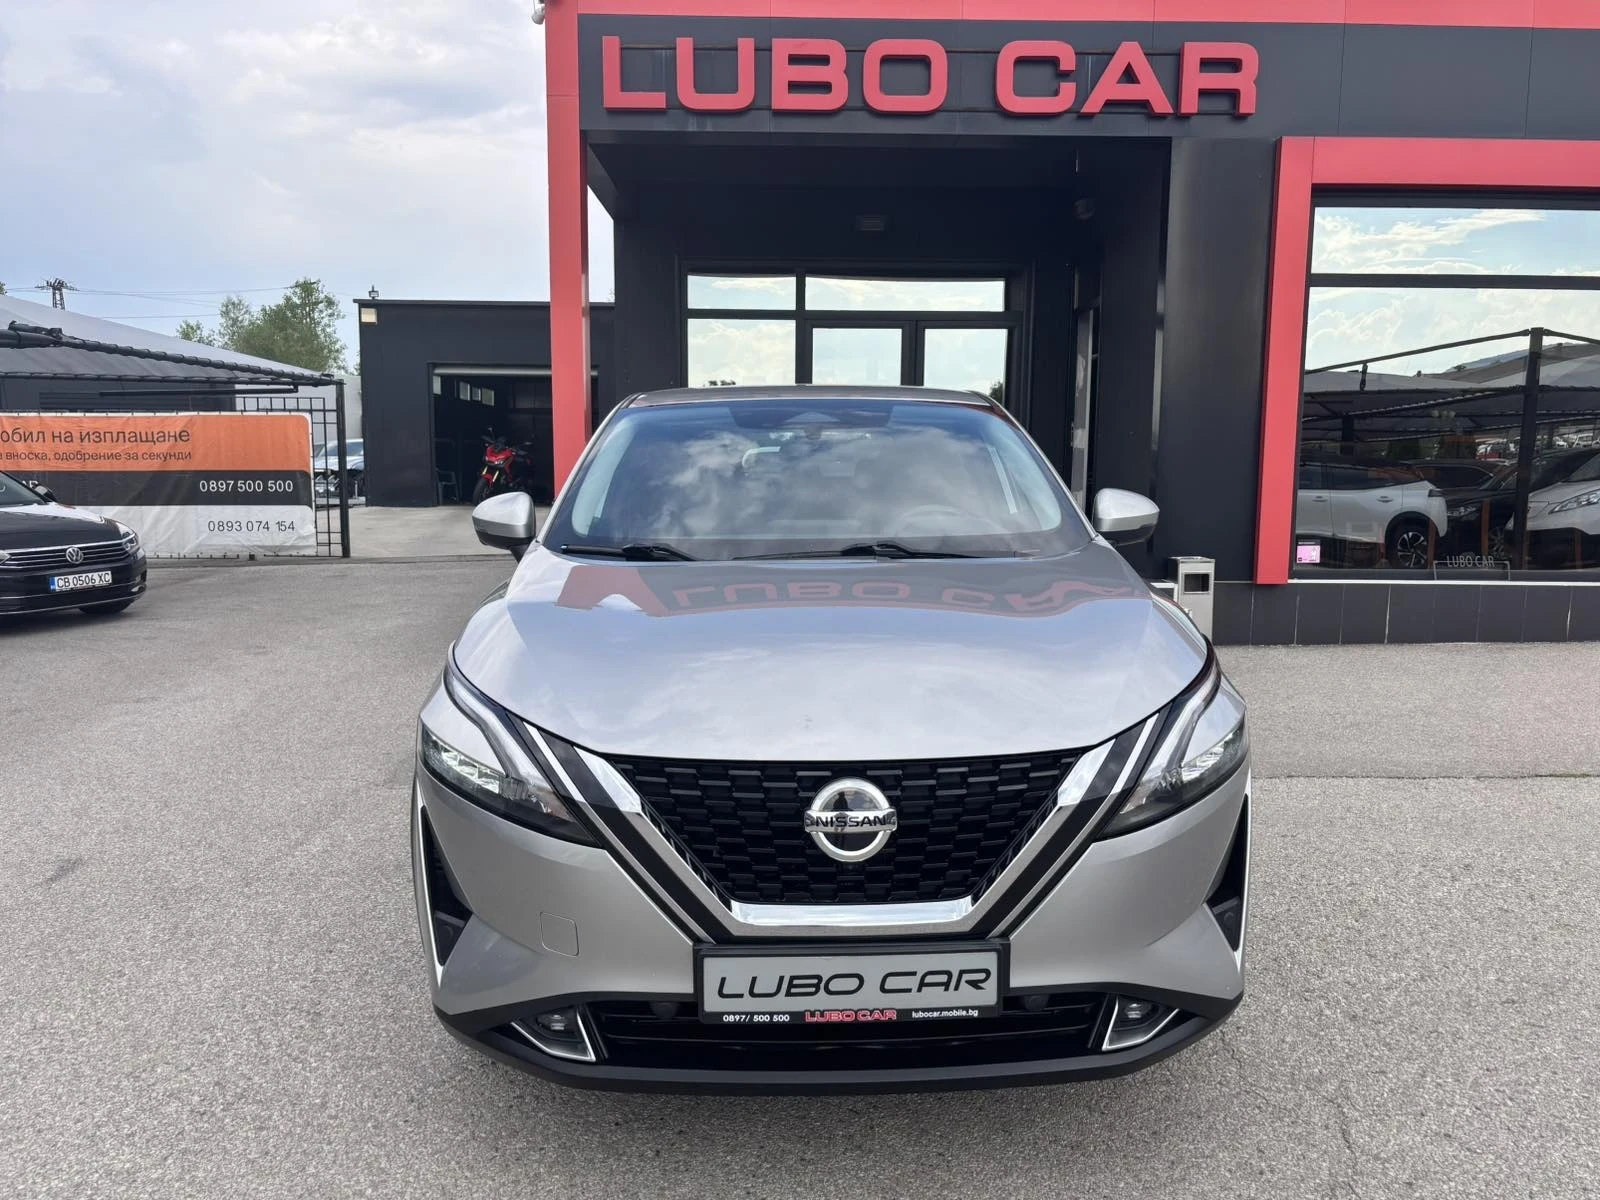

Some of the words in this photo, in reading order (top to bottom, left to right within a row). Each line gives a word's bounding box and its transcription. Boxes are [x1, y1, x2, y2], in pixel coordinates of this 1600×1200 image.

[602, 35, 948, 114] LUBO
[995, 40, 1259, 116] CAR
[0, 427, 46, 443] обил
[52, 430, 74, 443] на
[79, 429, 190, 445] изплащане
[53, 450, 121, 462] одобрение
[124, 451, 139, 461] за
[141, 451, 192, 462] секунди
[199, 480, 235, 492] 0897
[237, 480, 263, 492] 500
[267, 480, 294, 492] 500
[207, 520, 243, 532] 0893
[246, 520, 270, 532] 074
[275, 520, 296, 532] 154
[1446, 555, 1473, 568] LUBO
[1475, 555, 1495, 568] CAR
[72, 574, 96, 587] 0506
[815, 815, 886, 828] NISSAN
[717, 973, 865, 999] LUBO
[879, 968, 992, 993] CAR
[723, 1014, 750, 1023] 0897/
[753, 1014, 771, 1022] 500
[772, 1014, 790, 1022] 500
[804, 1010, 856, 1022] LUBO
[856, 1009, 898, 1021] CAR
[912, 1009, 979, 1018] lubocar.mobile.bg
